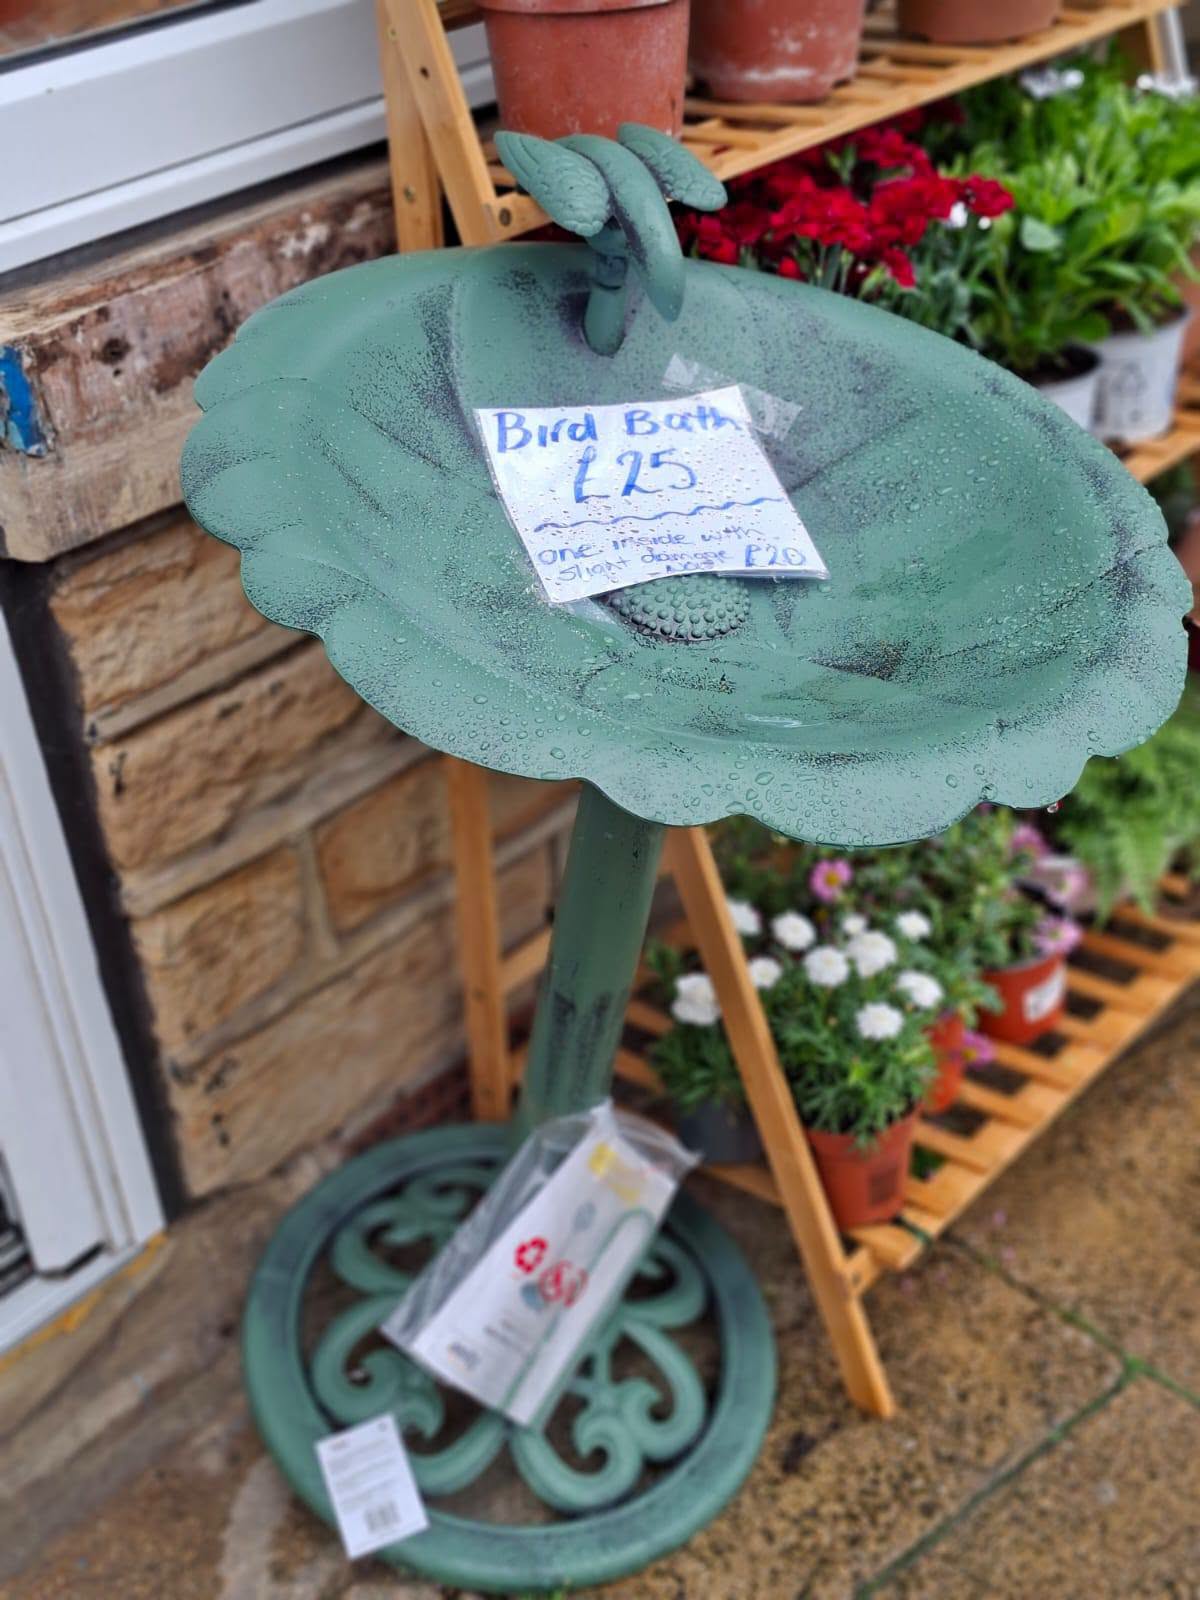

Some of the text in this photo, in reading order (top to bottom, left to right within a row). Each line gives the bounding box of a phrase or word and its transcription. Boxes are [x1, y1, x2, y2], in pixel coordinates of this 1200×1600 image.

[494, 406, 742, 453] Bird Bath
[573, 445, 698, 504] £25
[641, 546, 733, 564] damage
[745, 544, 807, 568] £20
